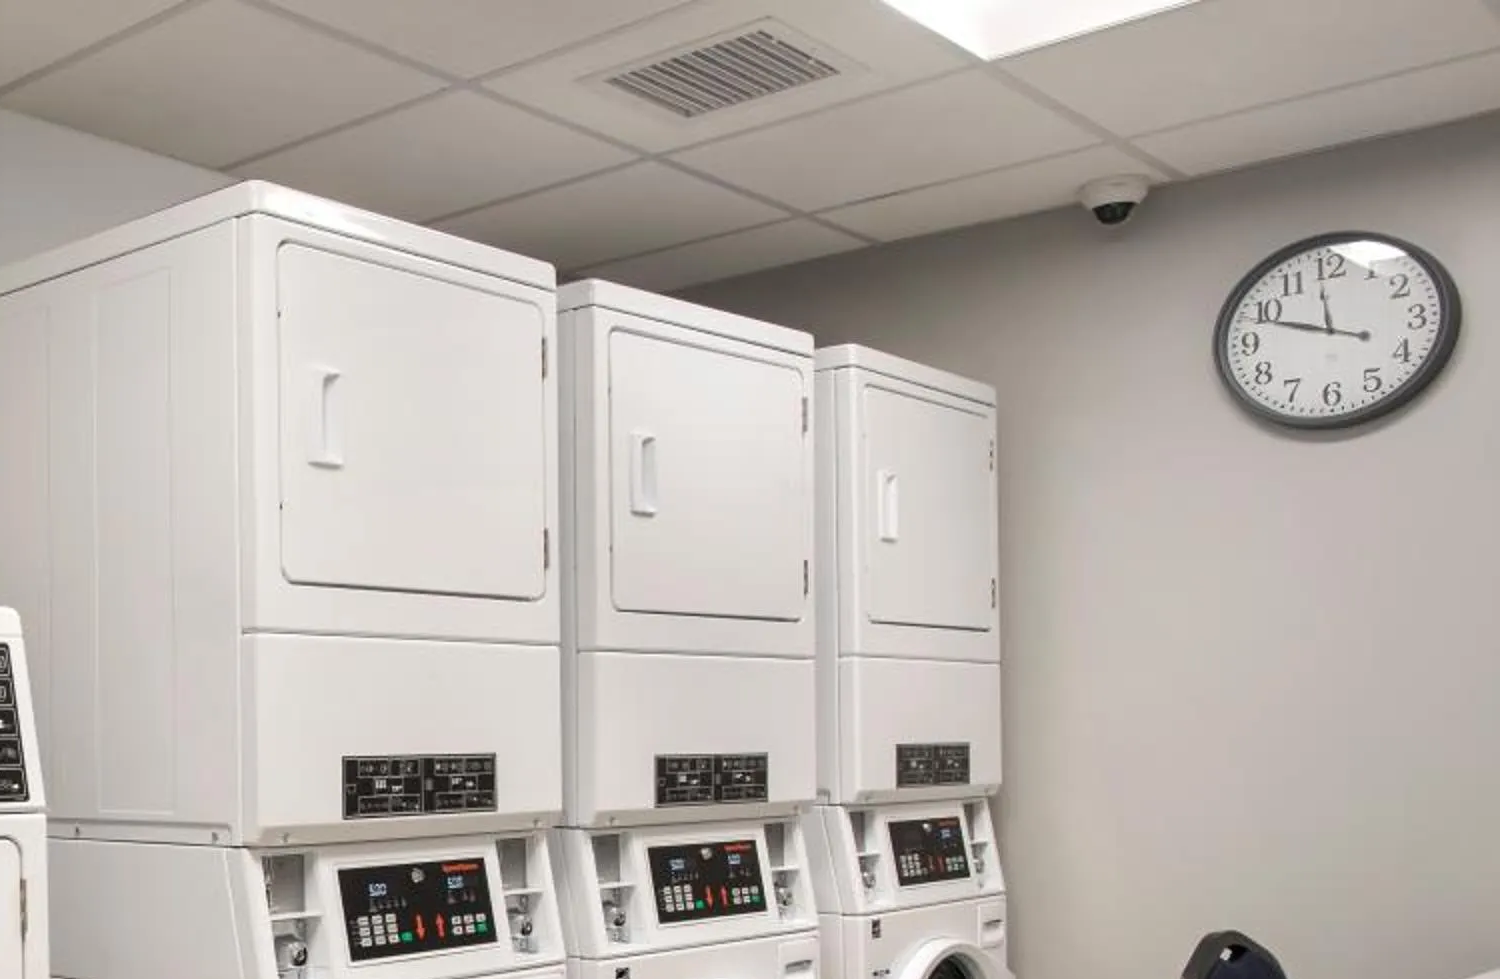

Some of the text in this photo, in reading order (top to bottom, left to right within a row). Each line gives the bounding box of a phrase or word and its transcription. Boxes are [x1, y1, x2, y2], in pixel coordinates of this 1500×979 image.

[1316, 253, 1346, 281] 12
[1281, 271, 1304, 297] 11
[1389, 273, 1411, 300] 2
[1252, 299, 1283, 325] 10
[1407, 304, 1427, 330] 3
[1241, 332, 1260, 356] 9
[1392, 336, 1411, 364] 4
[1254, 361, 1273, 385] 8
[1363, 367, 1382, 392] 5
[1283, 377, 1301, 403] 7
[1323, 382, 1341, 406] 6
